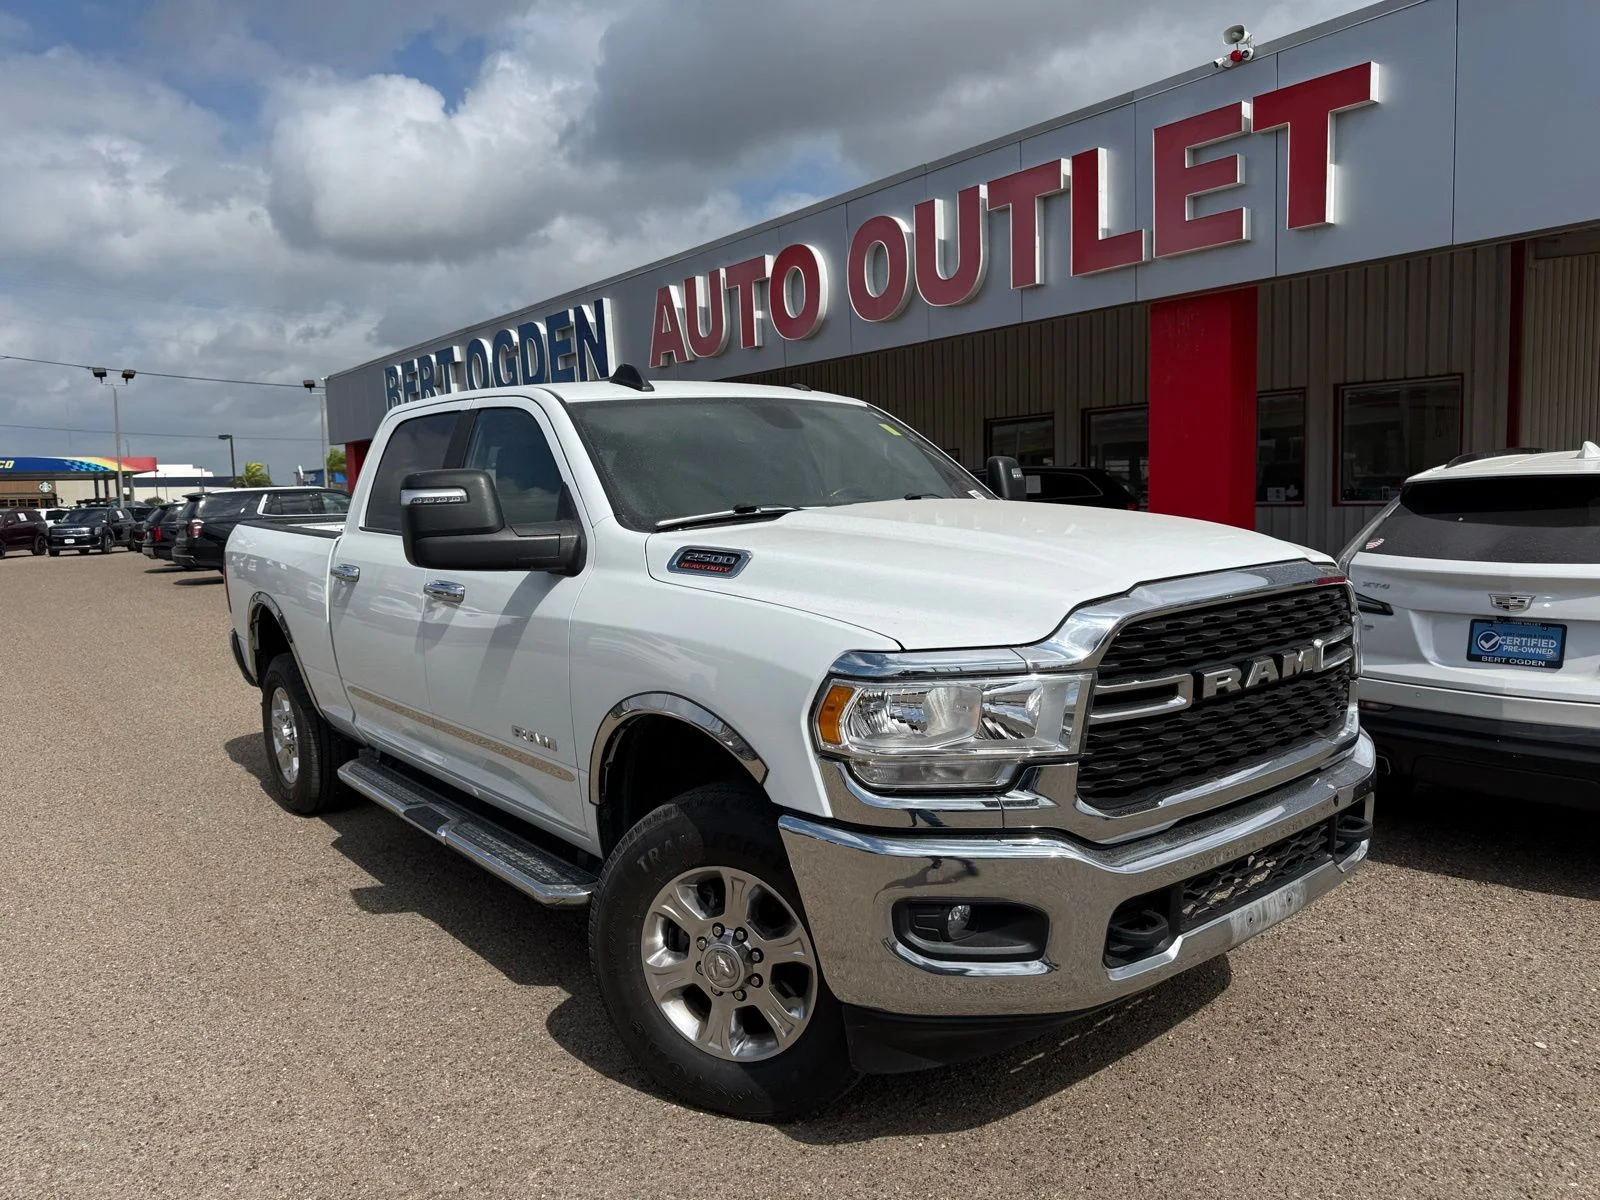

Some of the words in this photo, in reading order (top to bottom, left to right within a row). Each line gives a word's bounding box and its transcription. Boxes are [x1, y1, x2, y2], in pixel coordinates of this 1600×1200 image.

[649, 243, 828, 368] AUTO
[847, 61, 1379, 322] OUTLET
[384, 346, 461, 411] BERT
[465, 297, 614, 390] OGDEN
[684, 552, 736, 564] 2500
[1499, 635, 1557, 648] CERTIFIED
[1502, 645, 1554, 655] PRE-OWNED
[1481, 655, 1508, 663] BERT
[1509, 658, 1546, 667] OGDEN
[1203, 649, 1314, 699] RAM
[512, 725, 557, 752] RAM
